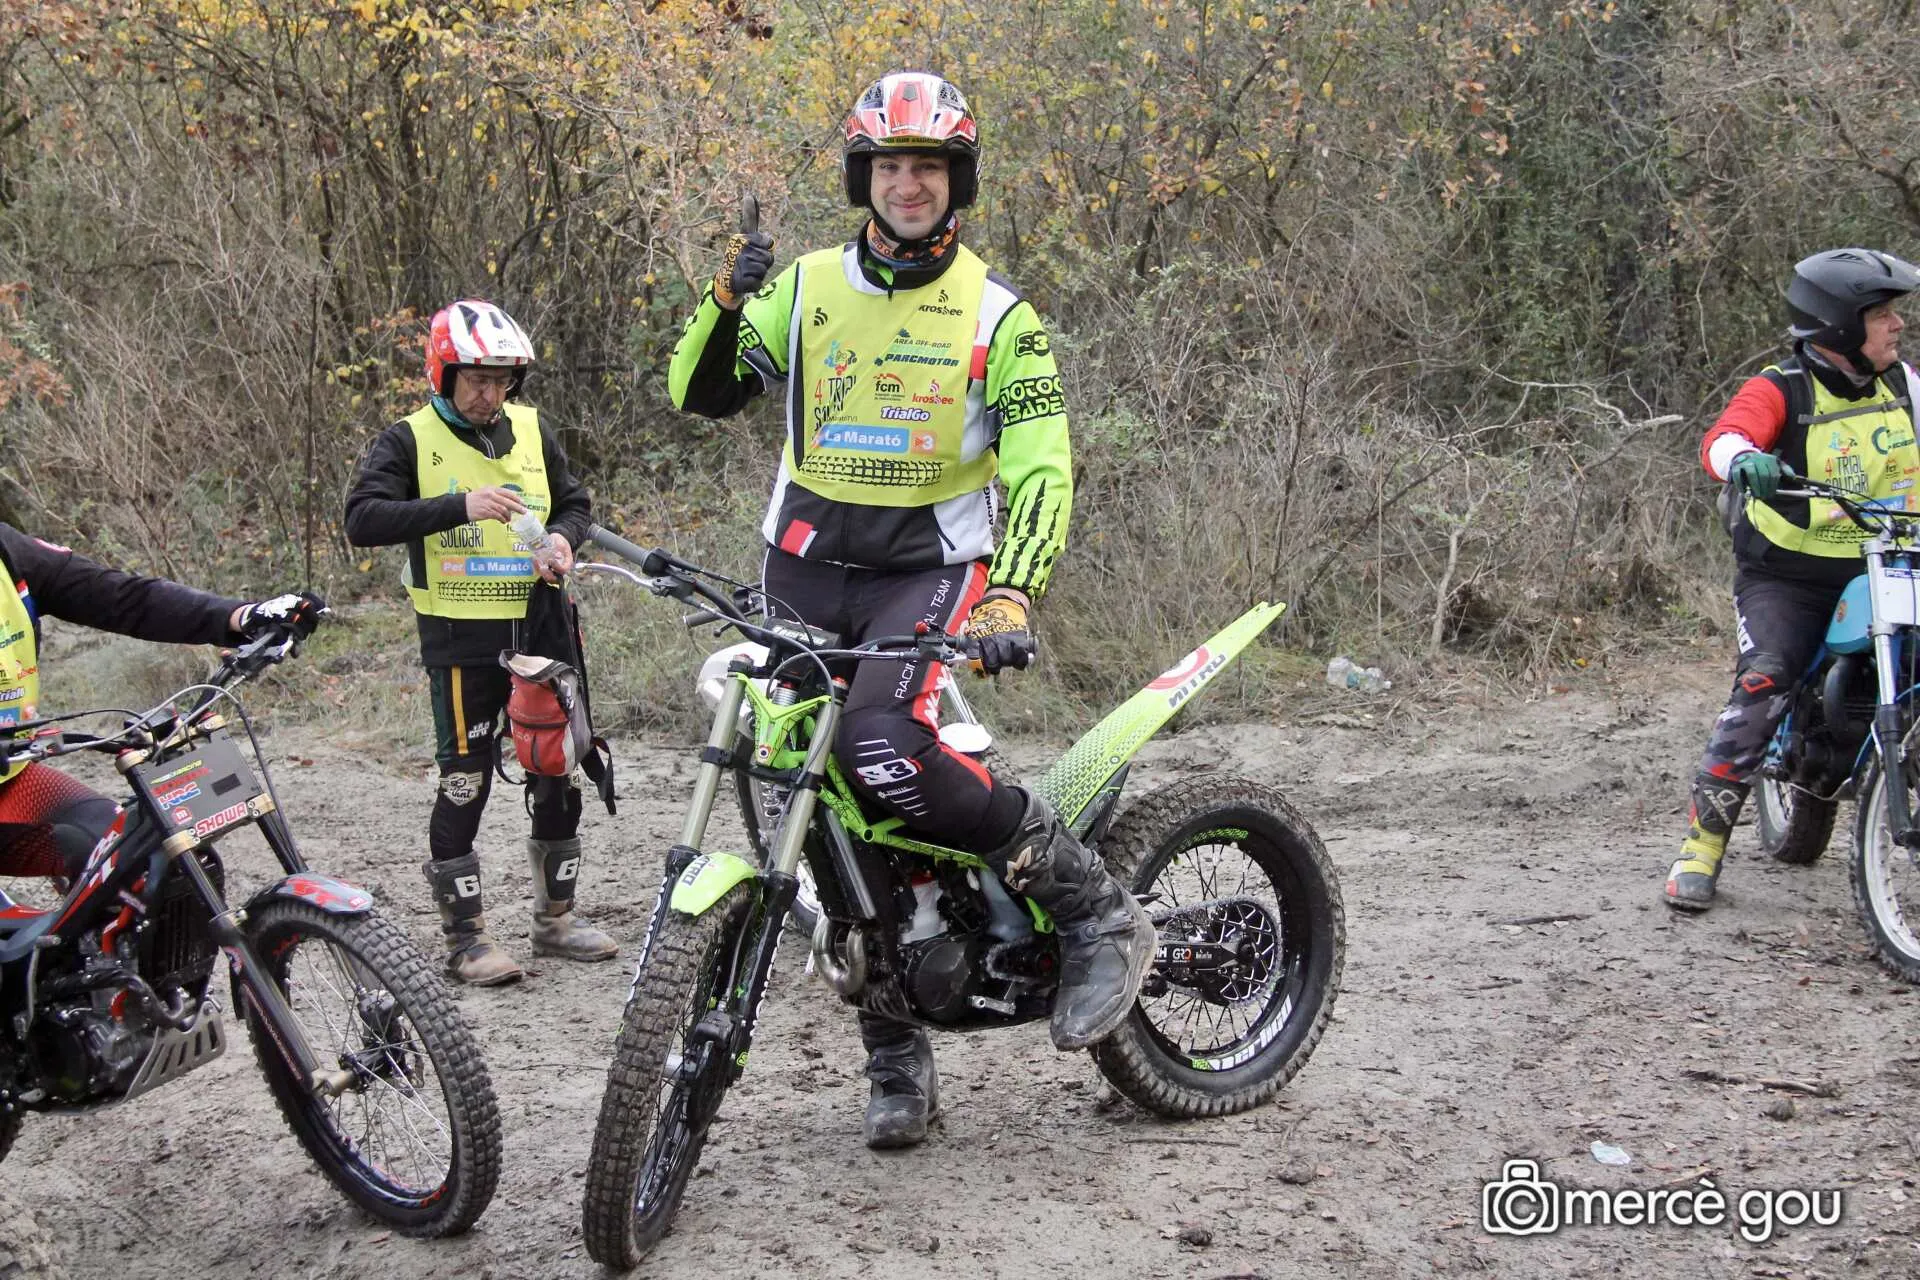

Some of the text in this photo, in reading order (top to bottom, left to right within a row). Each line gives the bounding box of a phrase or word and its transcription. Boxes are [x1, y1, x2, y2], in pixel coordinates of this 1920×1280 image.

[885, 353, 960, 367] PARCMOTOR
[875, 381, 900, 393] fcm
[880, 406, 931, 421] TrialGo
[825, 429, 902, 446] La Marató
[984, 486, 994, 530] ACING
[470, 561, 529, 572] La Marató
[931, 579, 952, 608] TEAM
[196, 801, 248, 837] SHOWA
